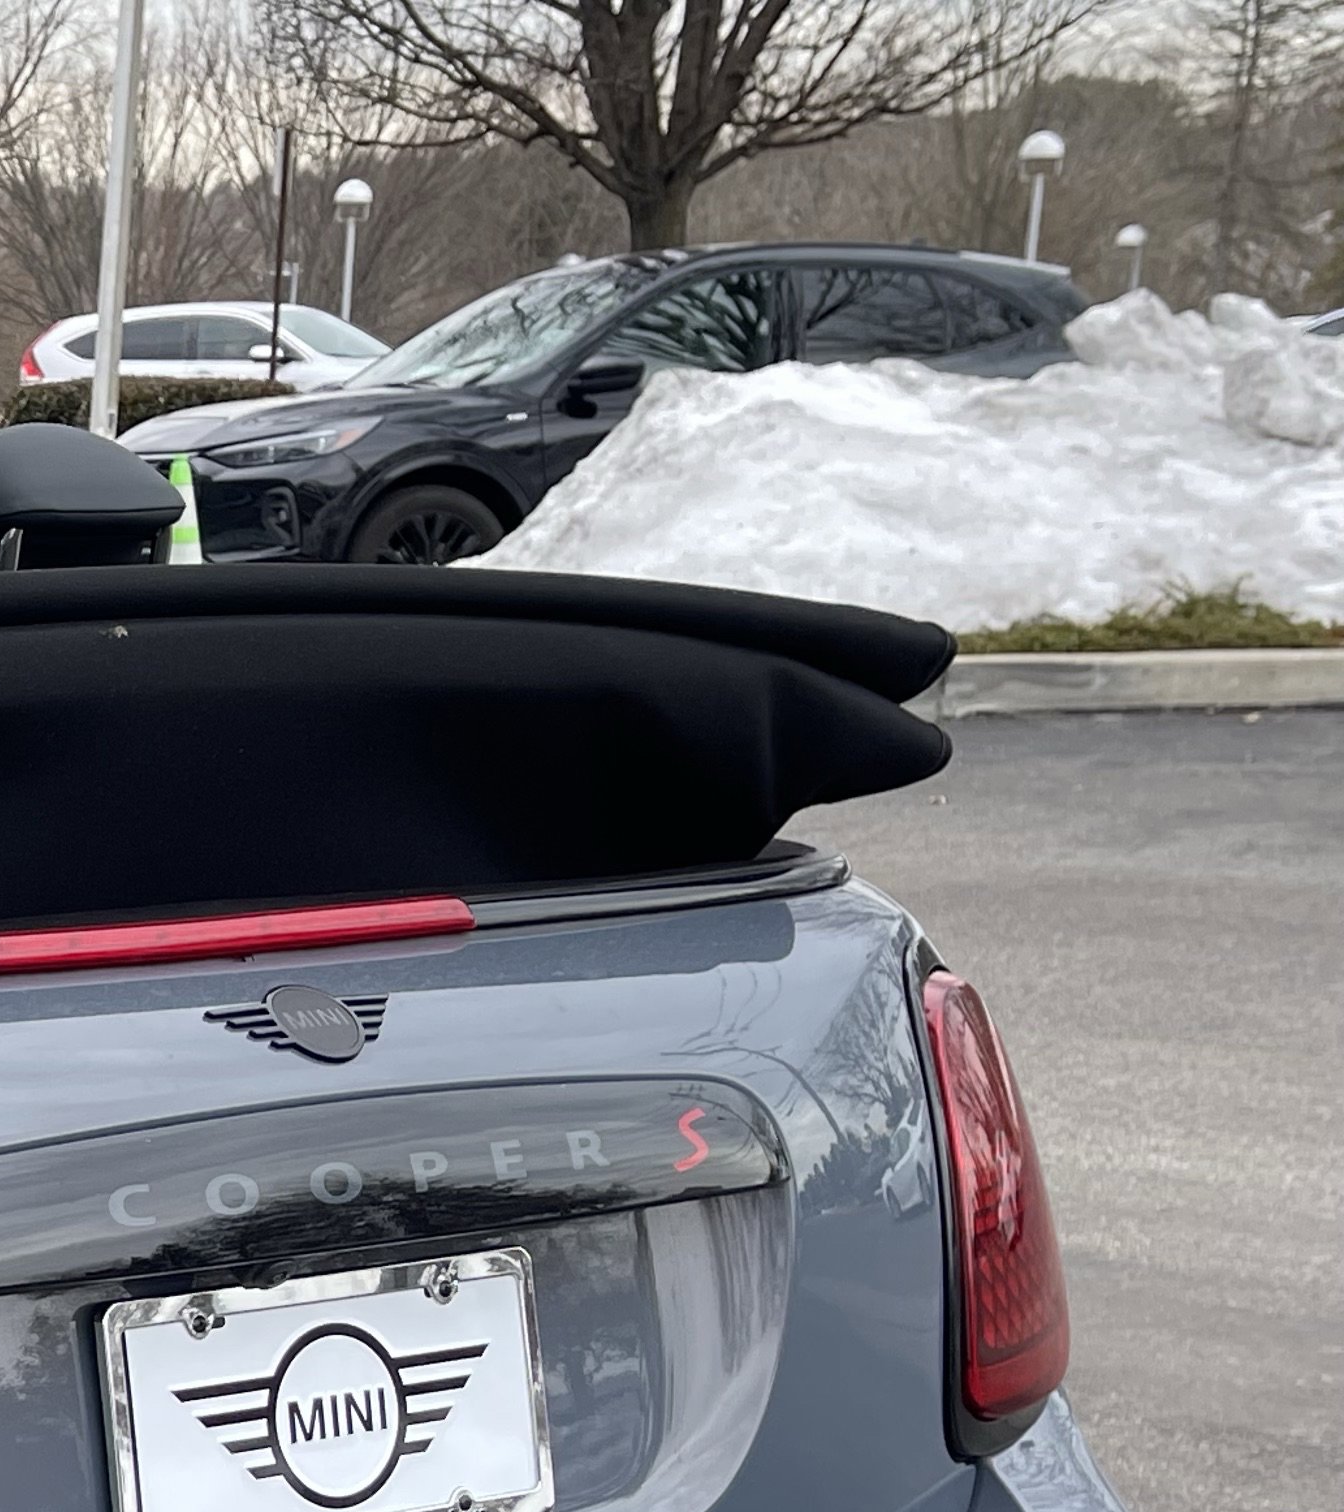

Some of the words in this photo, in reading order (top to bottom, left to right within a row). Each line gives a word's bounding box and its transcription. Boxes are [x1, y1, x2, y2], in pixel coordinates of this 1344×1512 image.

[282, 1007, 350, 1030] MINI
[108, 1130, 611, 1217] COOPER
[673, 1107, 709, 1172] S
[287, 1387, 388, 1445] MINI
